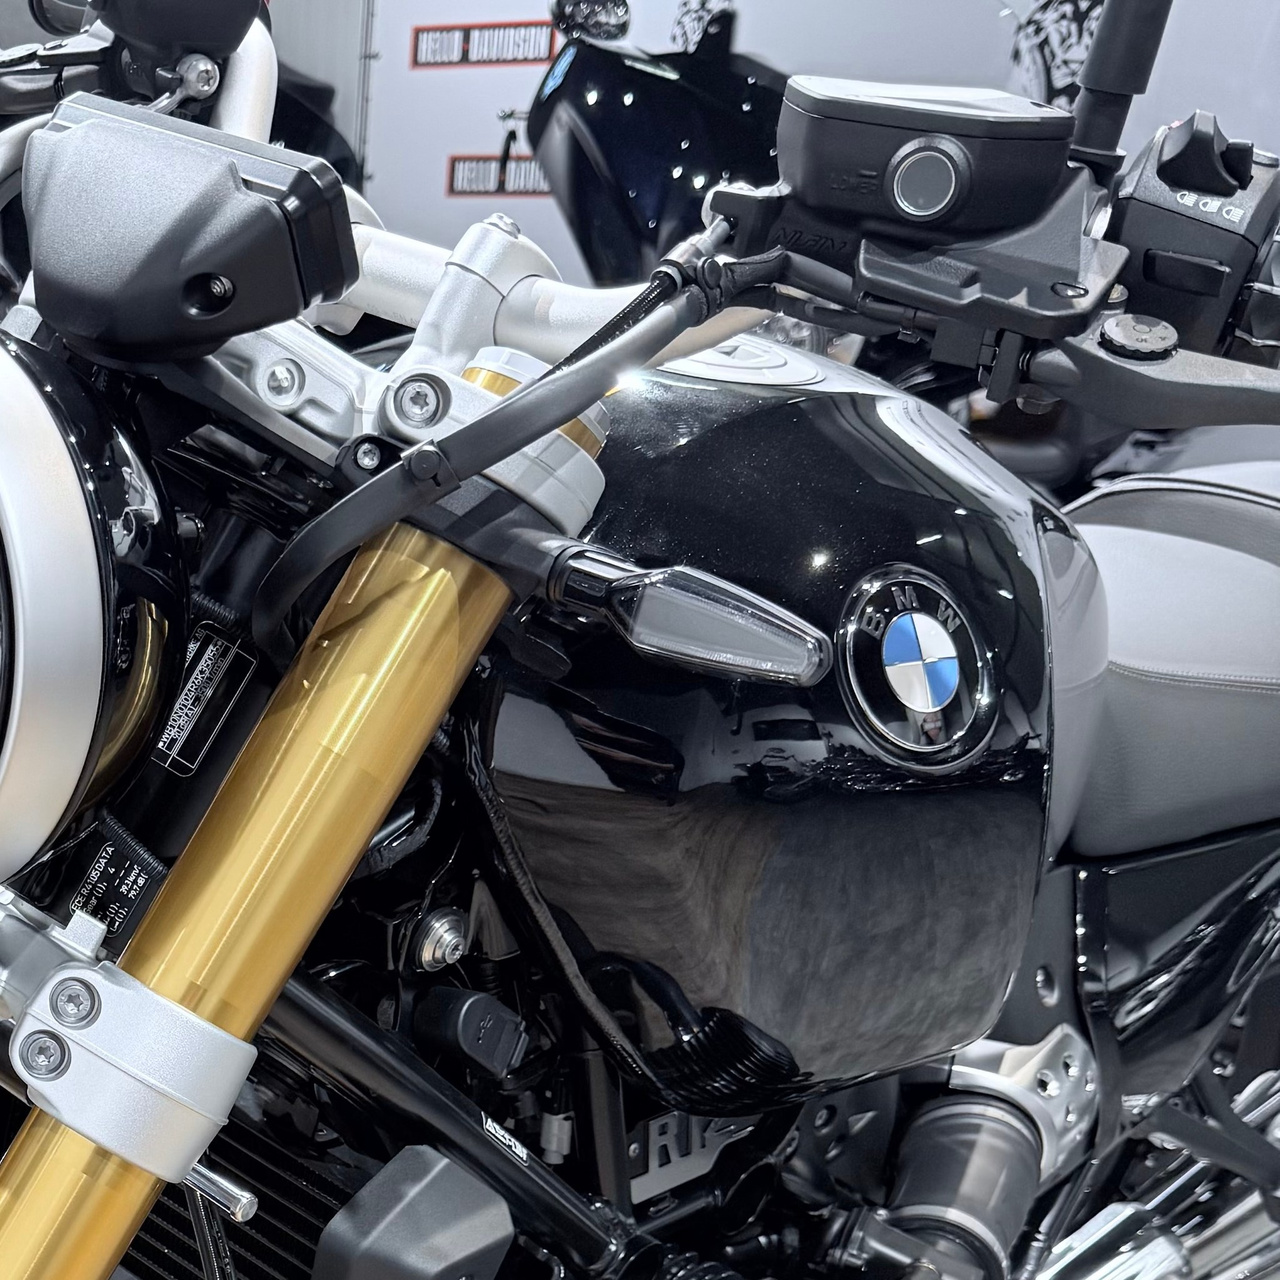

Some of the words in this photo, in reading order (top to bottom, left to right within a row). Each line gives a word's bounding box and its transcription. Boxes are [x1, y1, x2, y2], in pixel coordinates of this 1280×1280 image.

[860, 585, 962, 640] BMW
[95, 846, 115, 872] DATA
[107, 866, 116, 875] 4
